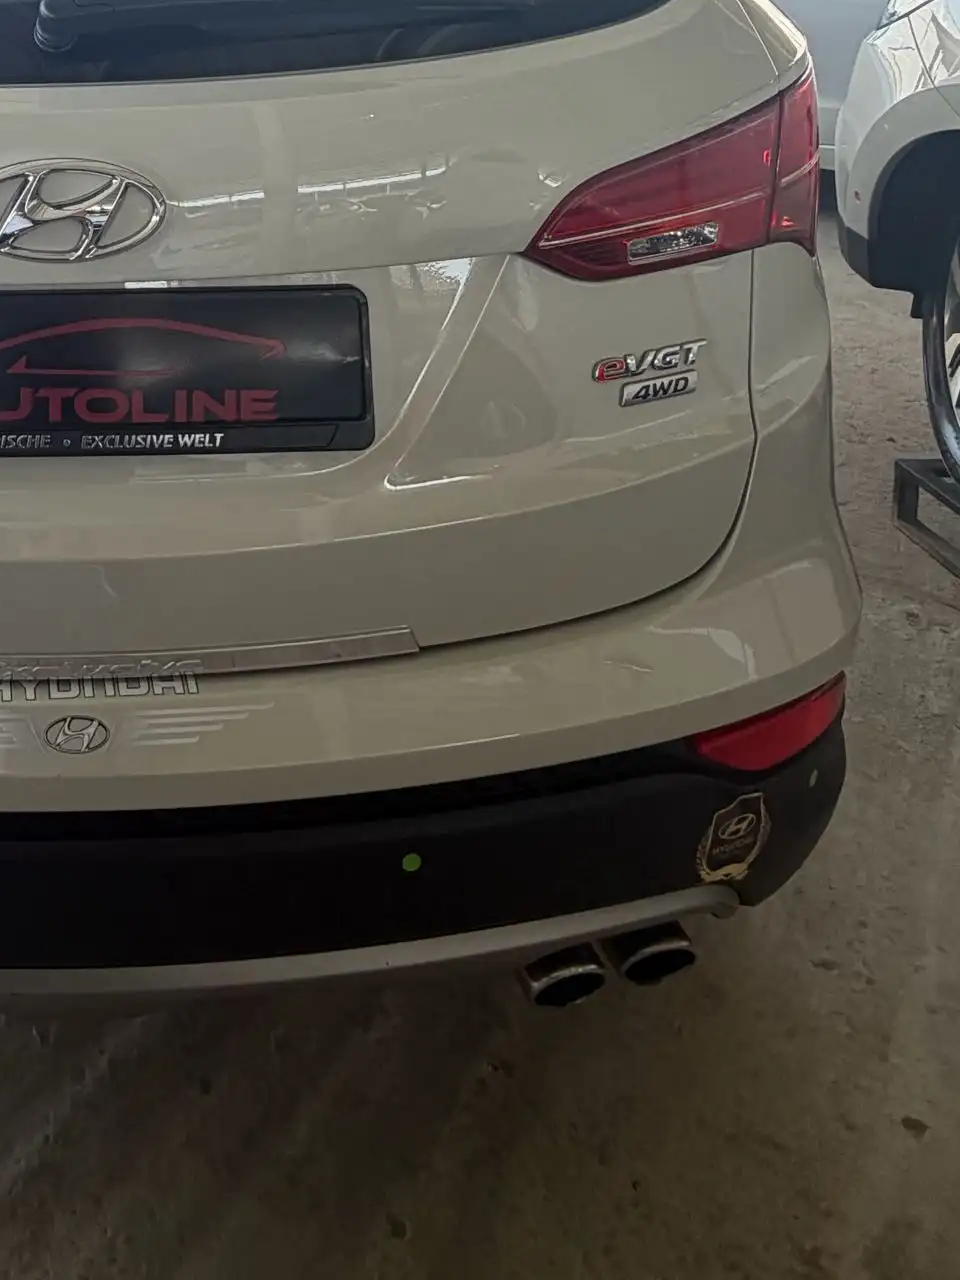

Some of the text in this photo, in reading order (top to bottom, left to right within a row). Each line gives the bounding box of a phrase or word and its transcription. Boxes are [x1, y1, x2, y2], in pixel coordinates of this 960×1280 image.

[592, 338, 708, 384] eVGT
[632, 376, 690, 401] 4WD
[81, 434, 174, 449] EXCLUSIVE
[178, 433, 225, 448] WELT
